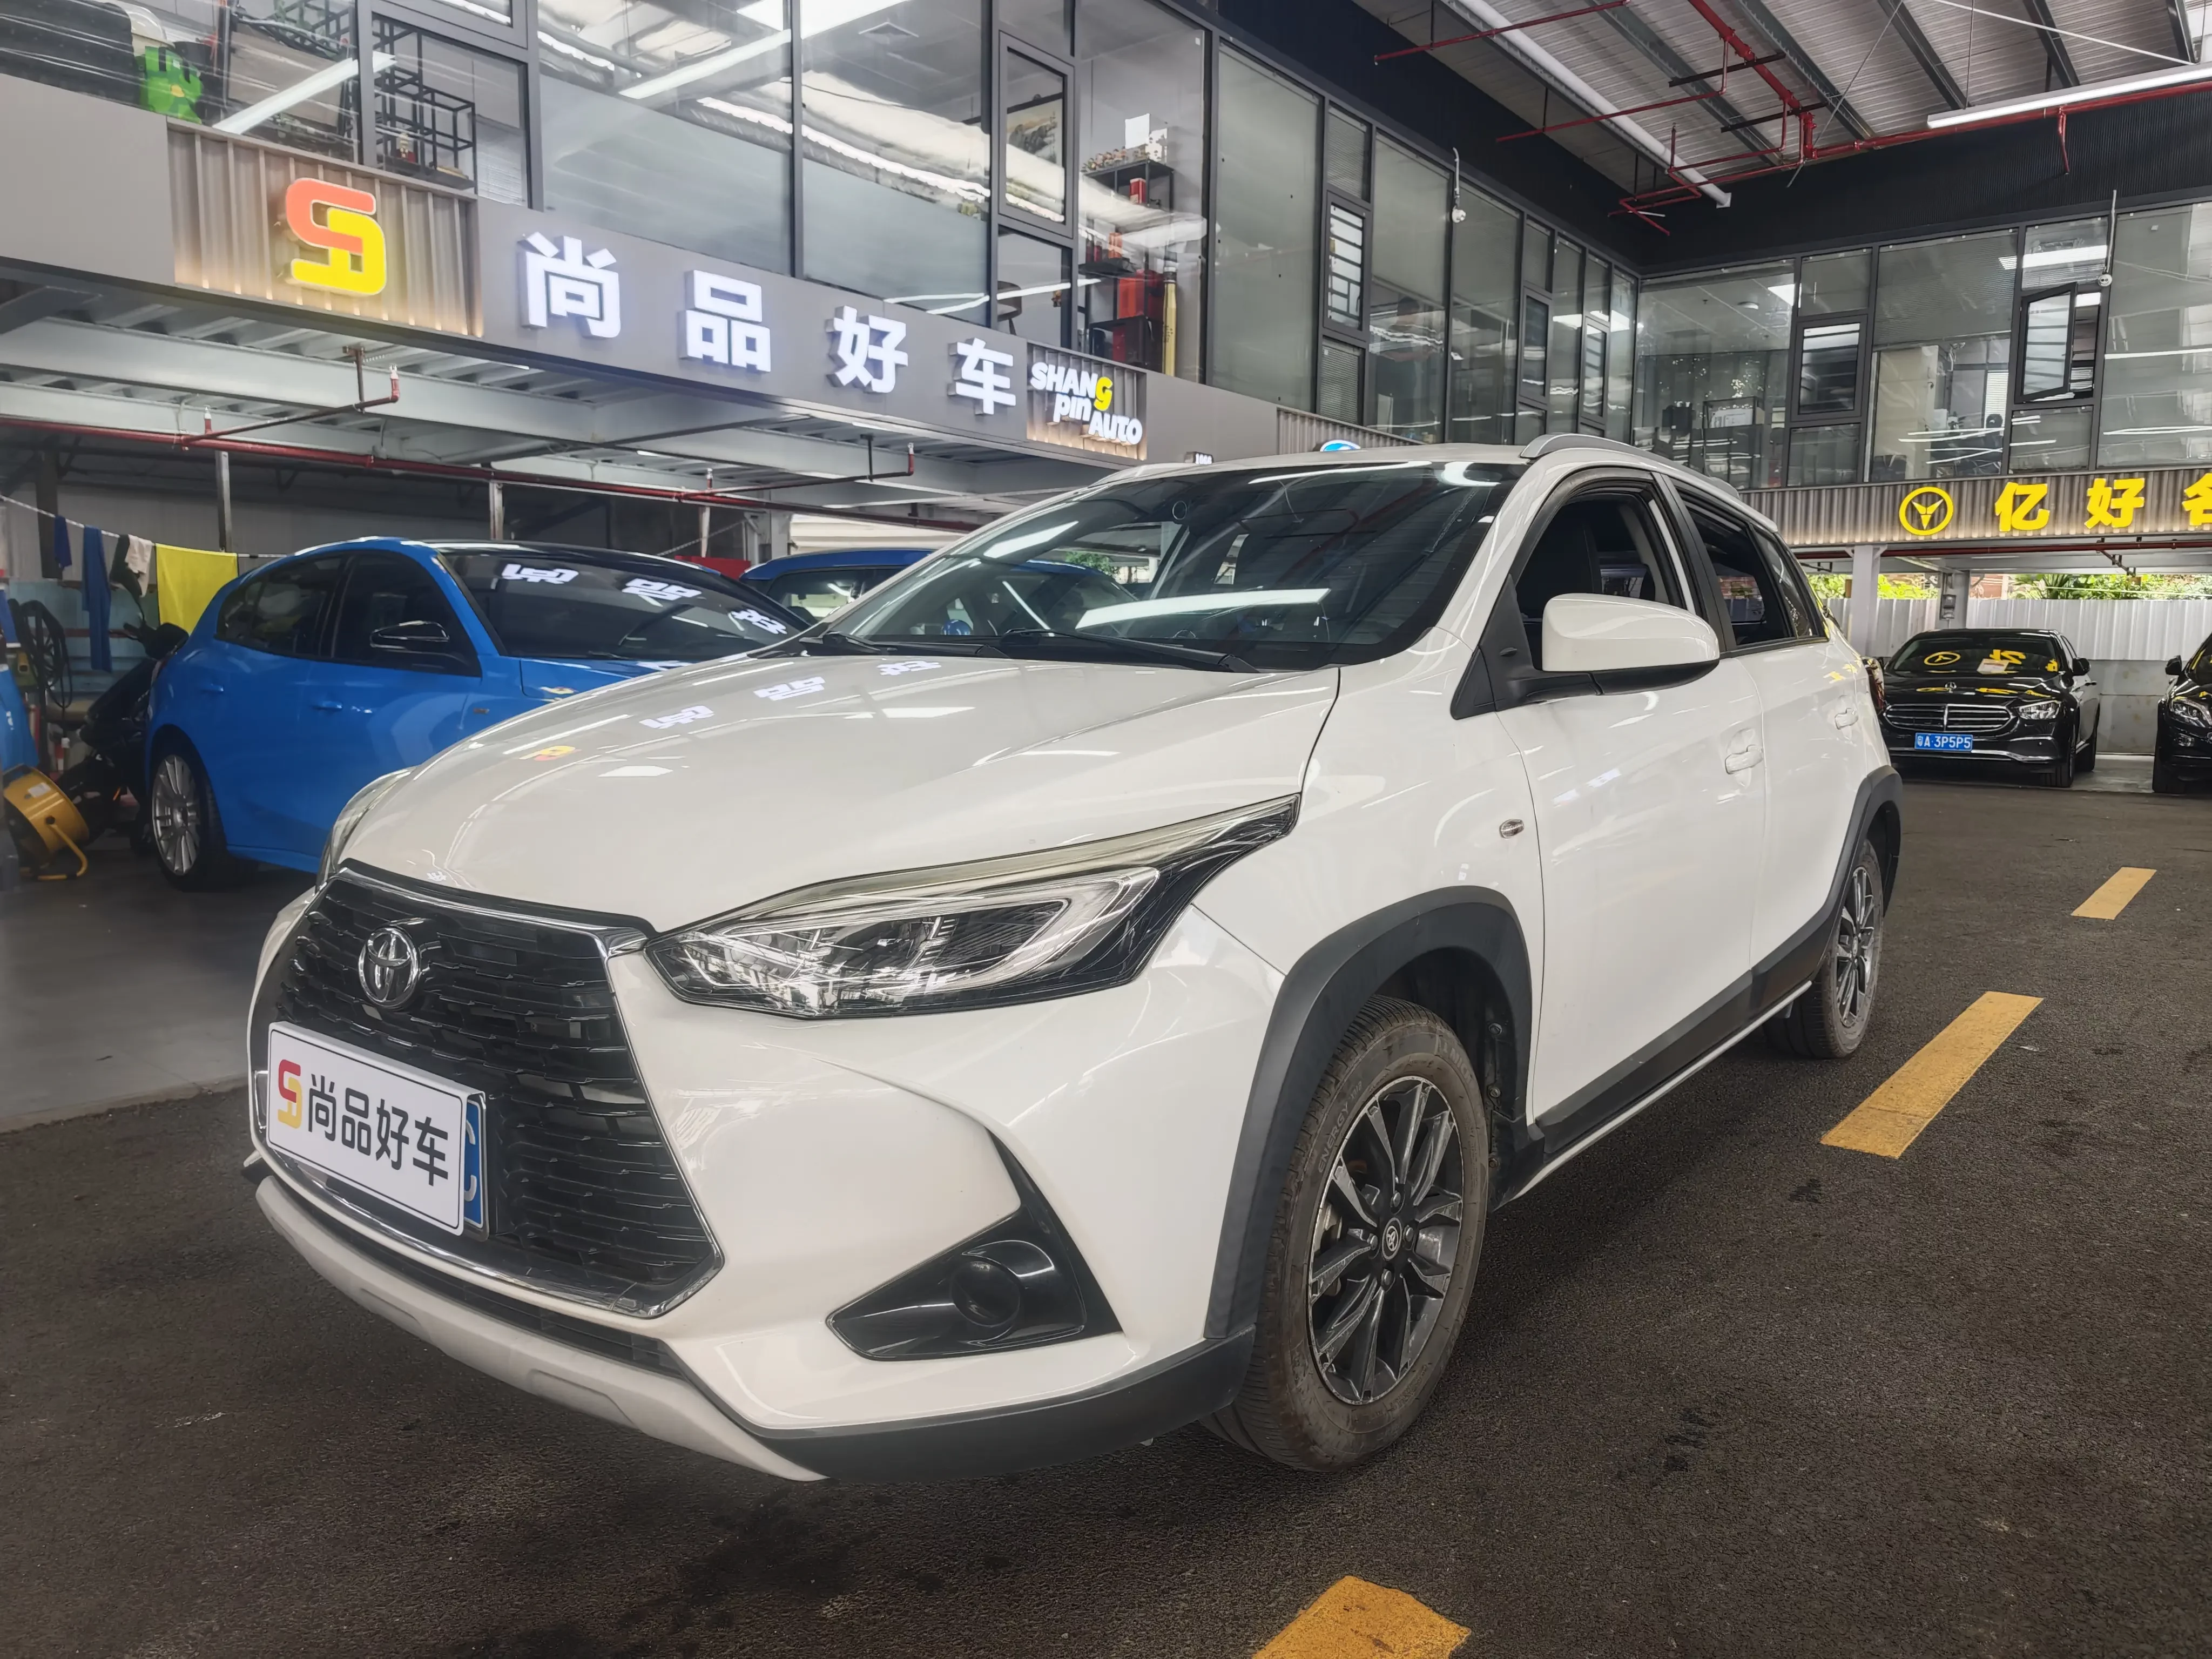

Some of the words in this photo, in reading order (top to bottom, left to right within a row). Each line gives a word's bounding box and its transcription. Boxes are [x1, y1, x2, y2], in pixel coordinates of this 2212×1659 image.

[519, 231, 1016, 415] 尚品好车
[1088, 410, 1143, 446] AUTO
[308, 1074, 449, 1186] 尚品好车
